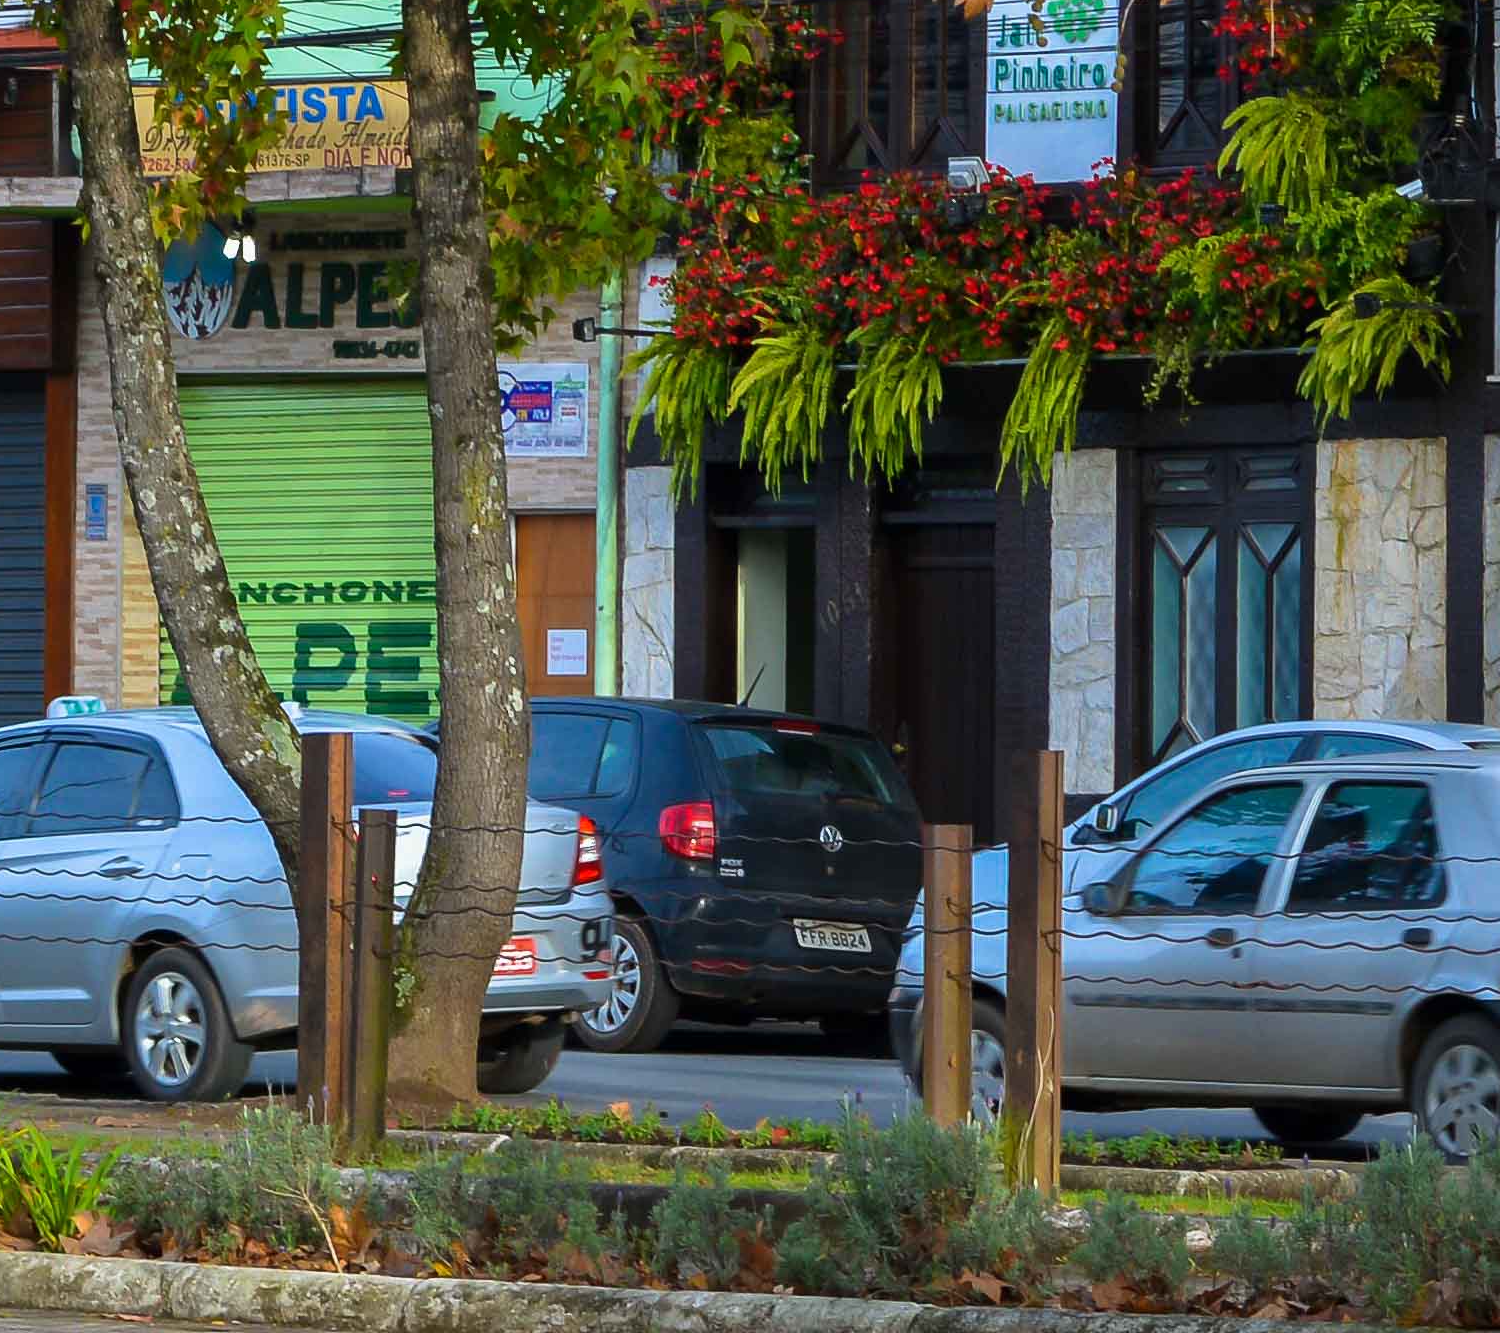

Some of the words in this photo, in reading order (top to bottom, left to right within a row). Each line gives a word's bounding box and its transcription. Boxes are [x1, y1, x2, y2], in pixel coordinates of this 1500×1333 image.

[995, 55, 1106, 93] Pinheiro
[994, 100, 1108, 123] PAISAGISMO
[324, 148, 354, 168] DIA
[361, 147, 372, 167] E
